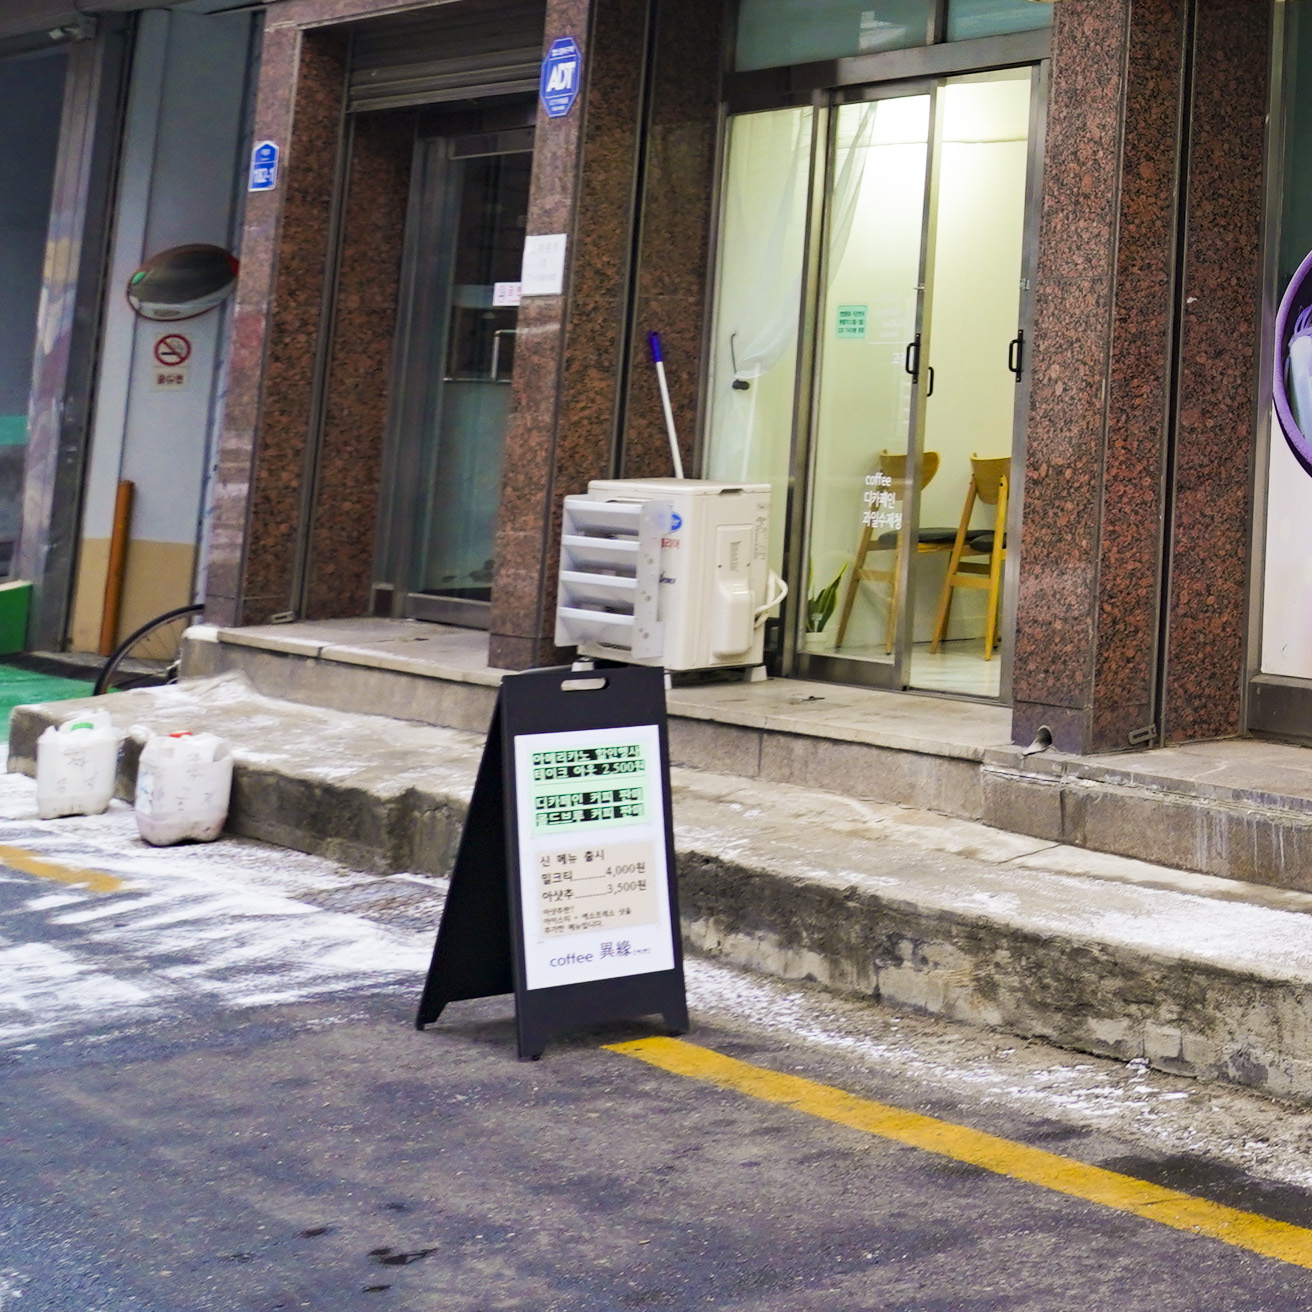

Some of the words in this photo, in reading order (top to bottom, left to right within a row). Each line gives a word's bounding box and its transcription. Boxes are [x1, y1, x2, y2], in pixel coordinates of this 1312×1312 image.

[545, 61, 577, 93] ADT
[864, 471, 892, 487] coffee
[549, 952, 594, 968] coffee
